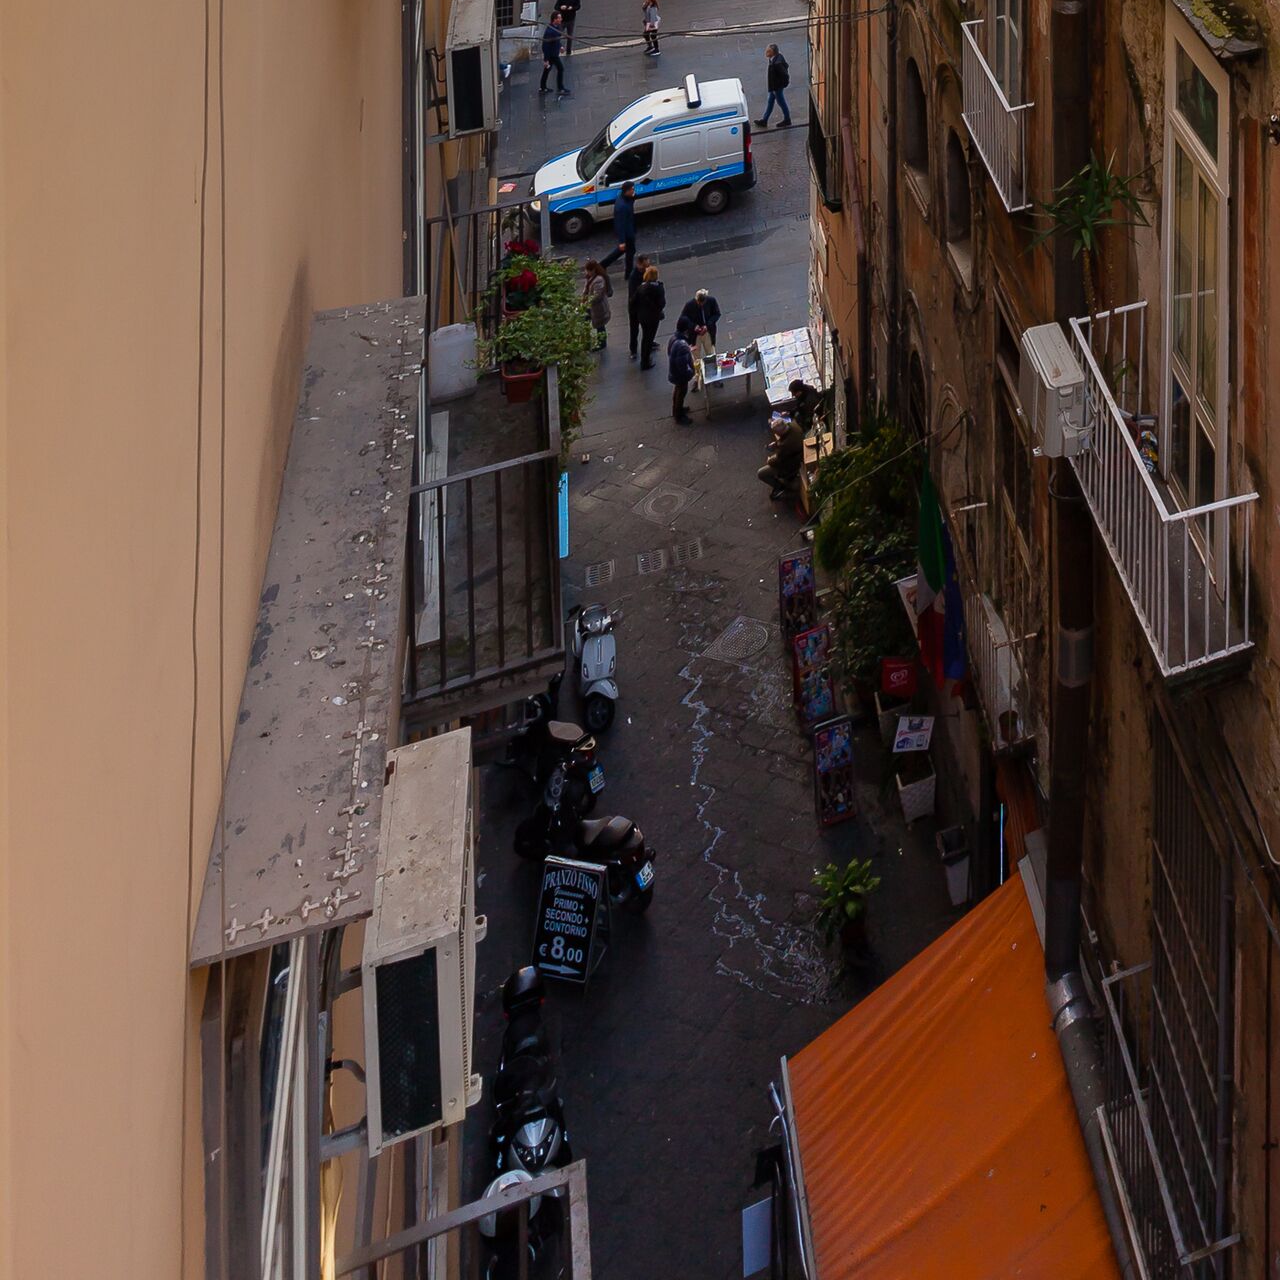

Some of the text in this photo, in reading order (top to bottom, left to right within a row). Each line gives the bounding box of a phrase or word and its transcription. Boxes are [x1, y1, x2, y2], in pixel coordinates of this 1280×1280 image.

[655, 175, 700, 188] Municipale
[545, 869, 577, 890] PRANZO
[577, 872, 598, 900] FISSO
[553, 897, 579, 911] PRIMO
[545, 907, 583, 925] SECONDO
[544, 920, 587, 937] CONTORNO
[538, 935, 584, 964] € 8,00
